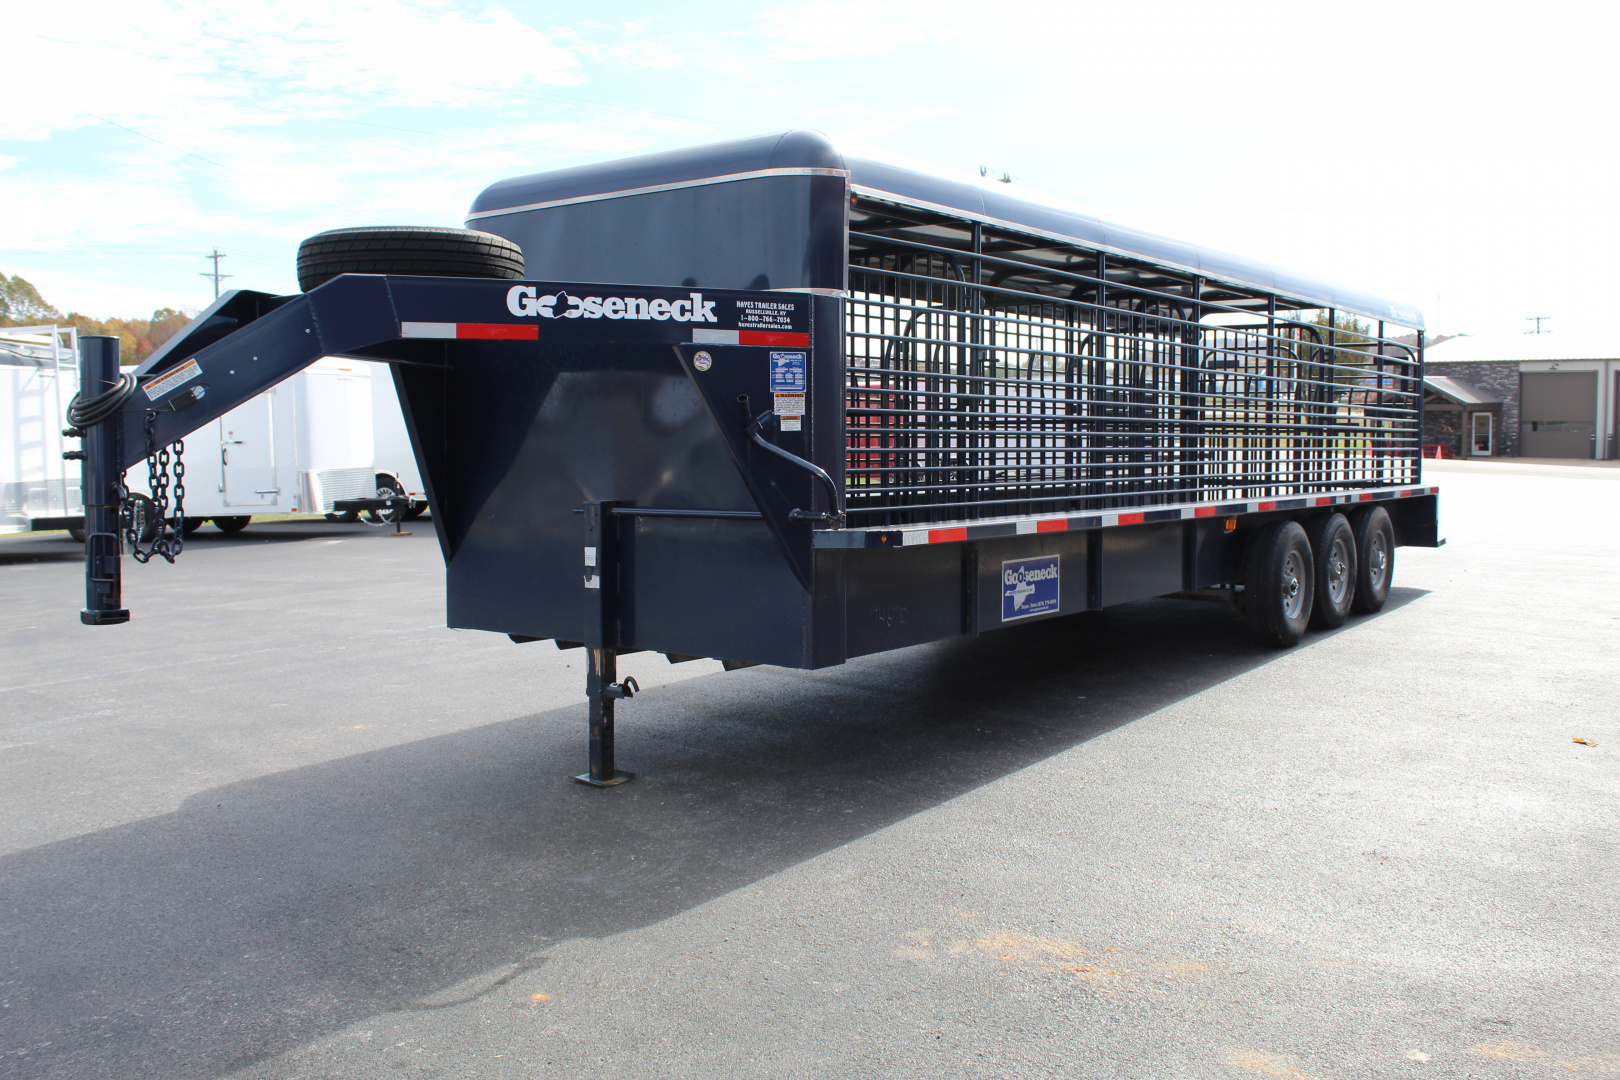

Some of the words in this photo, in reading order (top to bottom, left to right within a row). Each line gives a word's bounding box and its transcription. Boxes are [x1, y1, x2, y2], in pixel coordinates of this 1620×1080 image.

[506, 285, 718, 322] Gooseneck
[755, 302, 777, 310] TRAILER
[778, 303, 795, 311] SALES
[738, 322, 793, 330] hayestrailersales.com
[1004, 564, 1058, 585] Gooseneck
